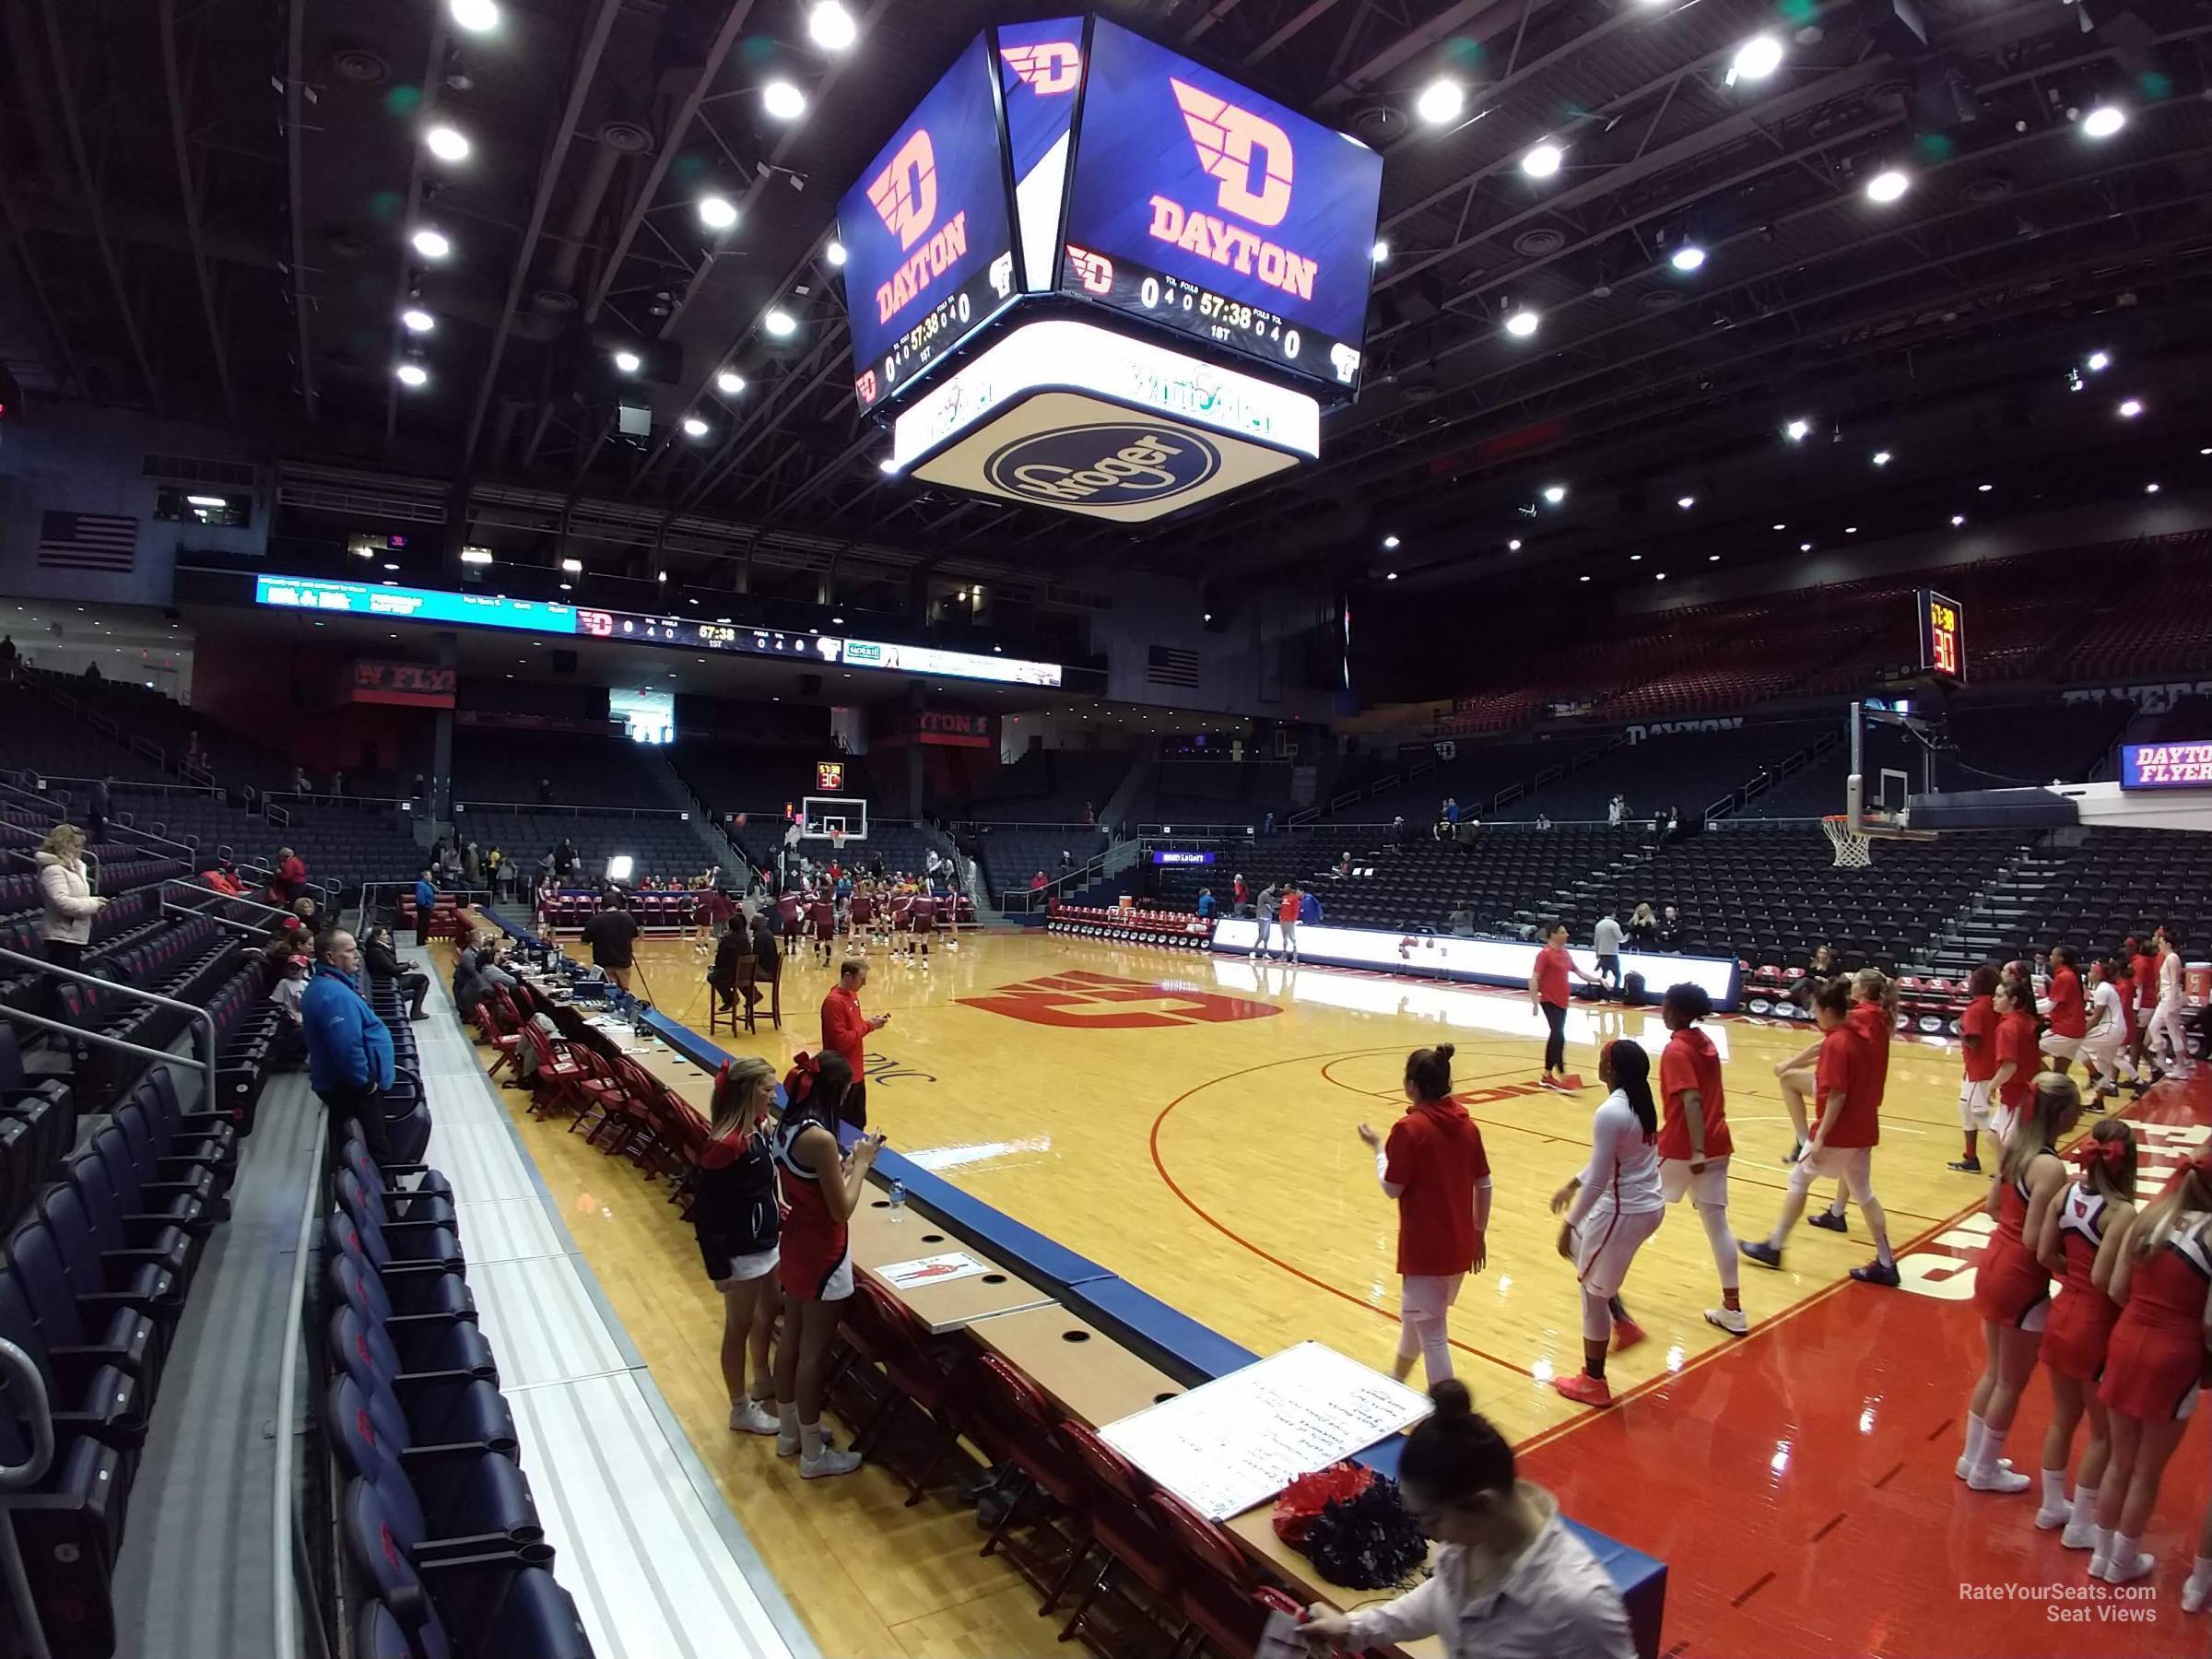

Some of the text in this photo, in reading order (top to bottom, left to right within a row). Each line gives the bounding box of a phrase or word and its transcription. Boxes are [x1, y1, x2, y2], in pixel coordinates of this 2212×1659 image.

[877, 210, 967, 324] DAYTON
[1149, 195, 1318, 300] DAYTON
[1141, 277, 1300, 359] 0 4 0 57:38 0 4 0
[1181, 281, 1198, 293] FOULS
[886, 356, 895, 382] 0
[903, 346, 910, 359] 0
[911, 312, 938, 350] 57:38
[941, 312, 947, 328] 0
[959, 293, 970, 323] 0
[1210, 324, 1230, 341] 1ST
[1014, 434, 1184, 500] Kroger
[647, 627, 654, 637] 4
[665, 629, 674, 639] 0
[699, 625, 735, 641] 57:38
[758, 638, 765, 649] 0
[775, 640, 782, 651] 4
